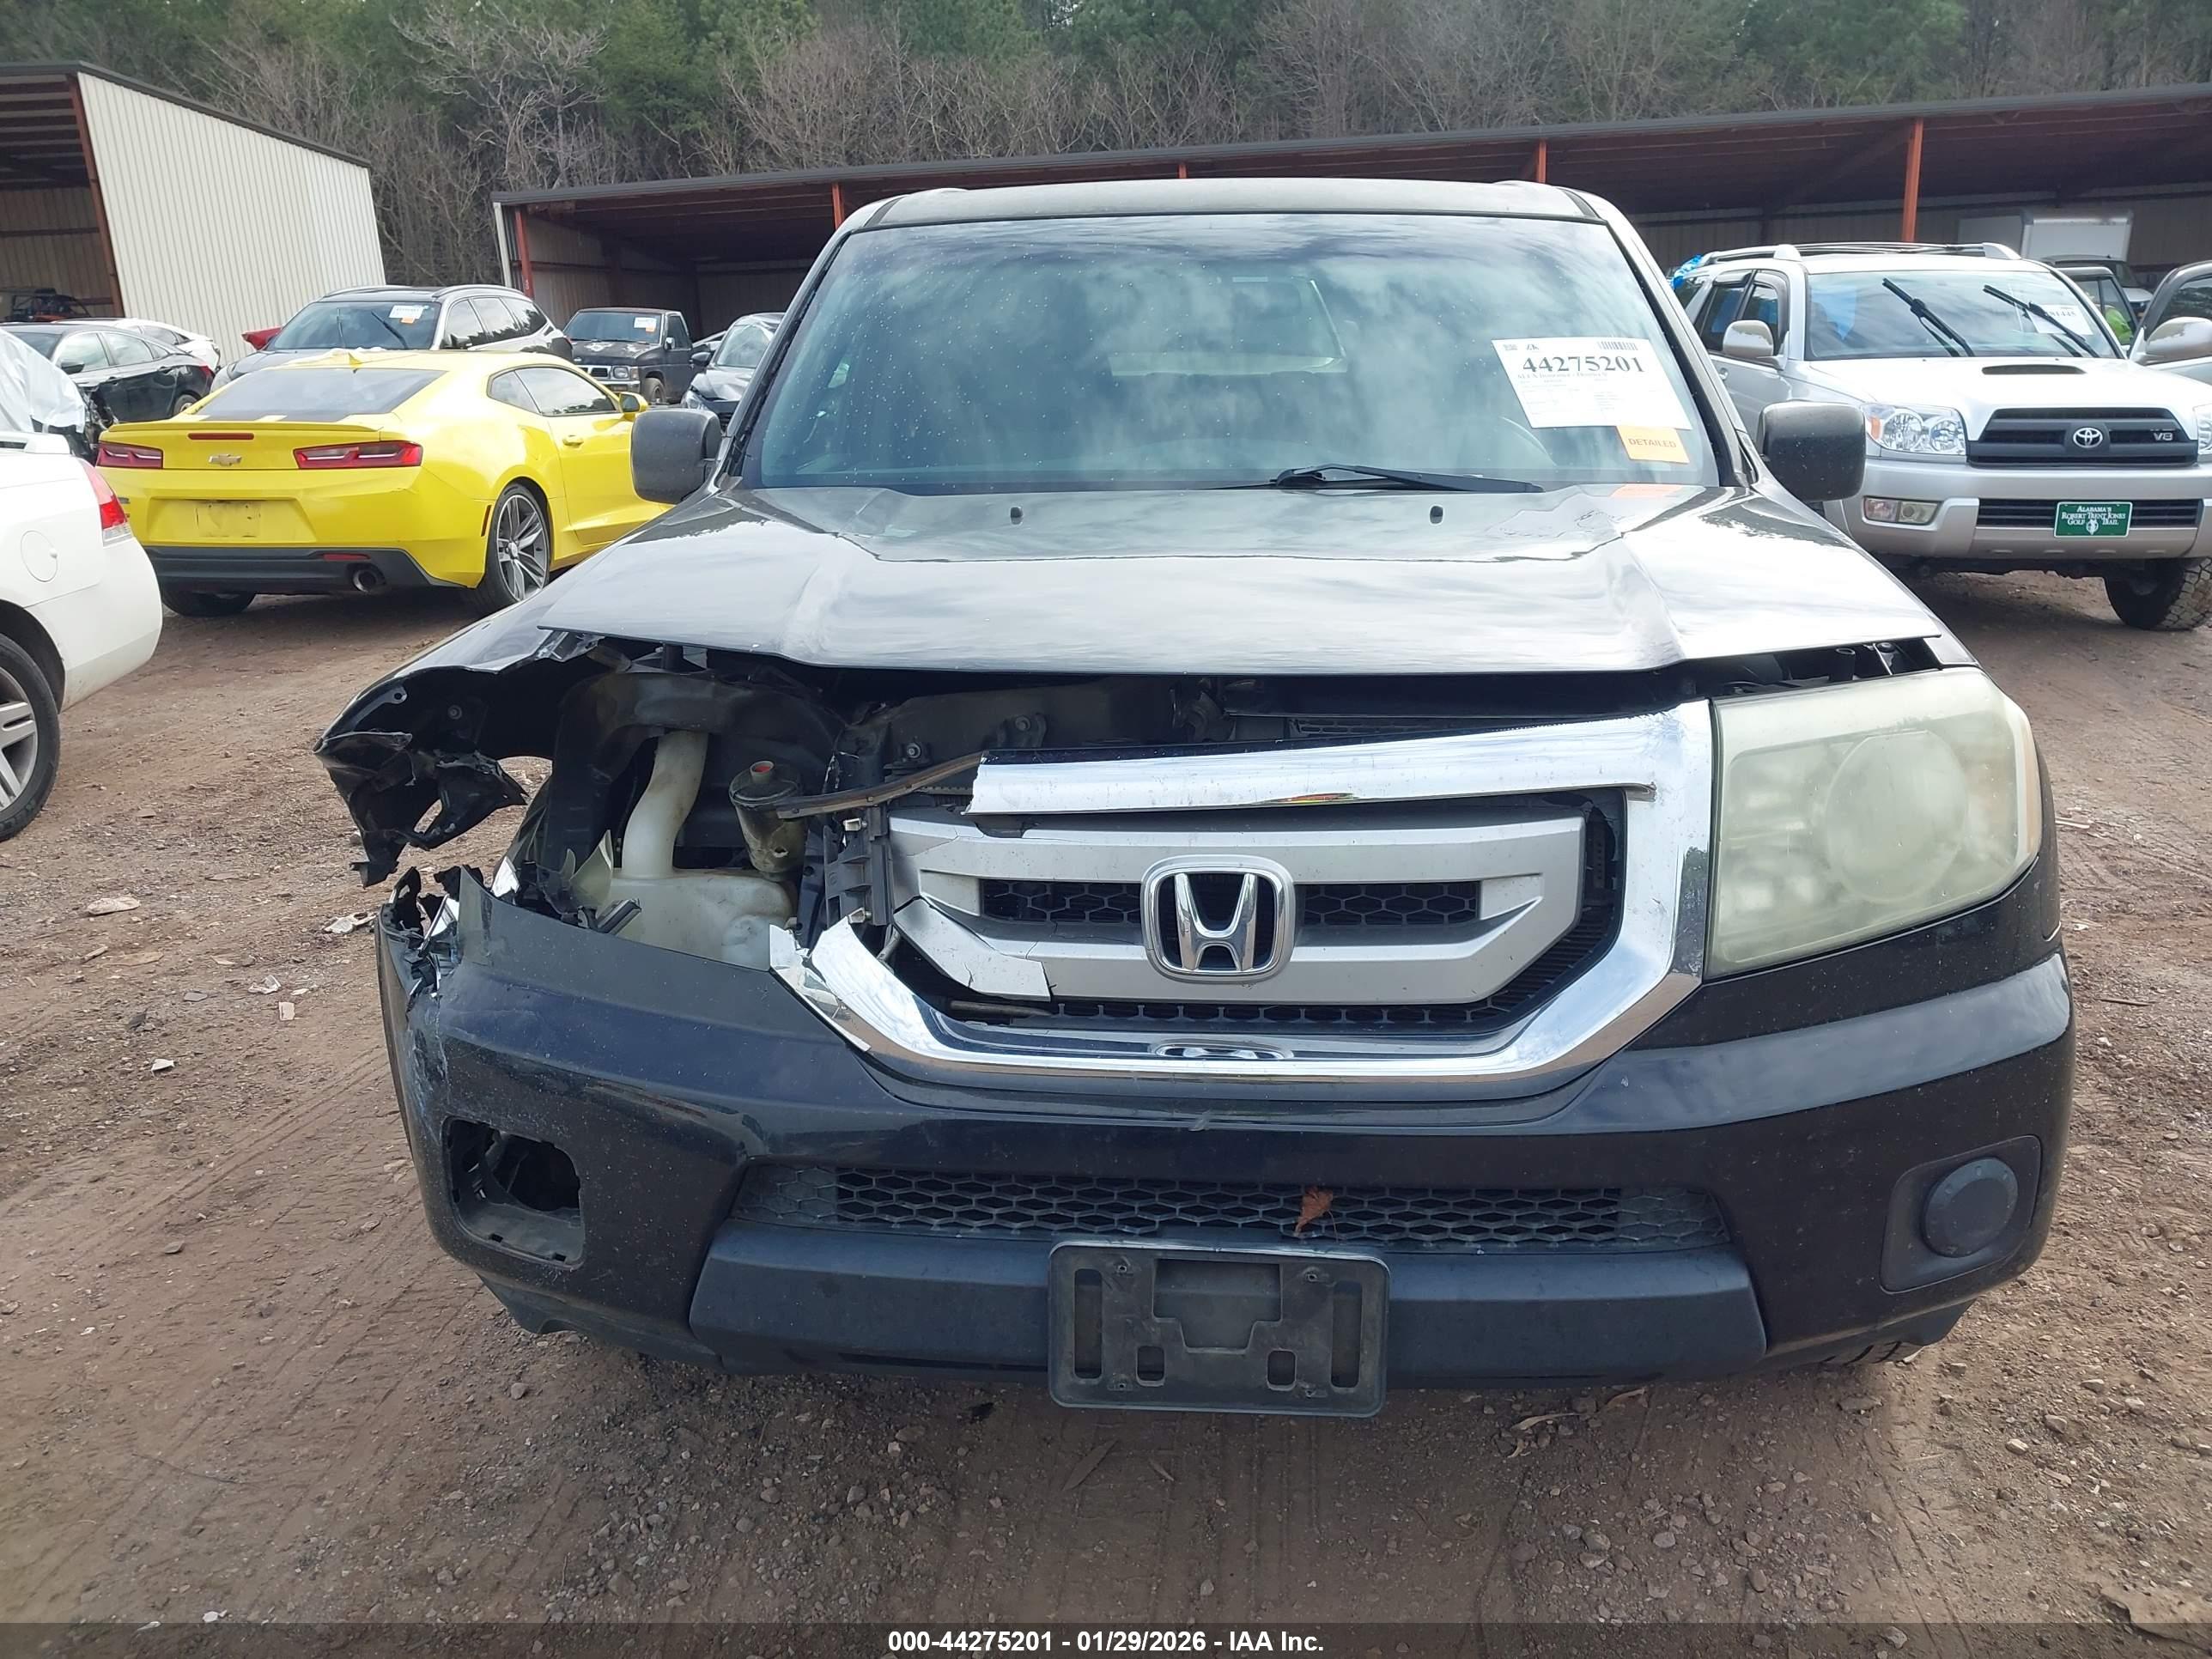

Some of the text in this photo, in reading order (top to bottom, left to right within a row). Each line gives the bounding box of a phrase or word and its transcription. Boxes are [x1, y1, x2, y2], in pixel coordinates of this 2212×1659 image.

[1522, 356, 1645, 373] 44275201
[2154, 432, 2173, 441] V8
[1628, 438, 1677, 448] DETAILED
